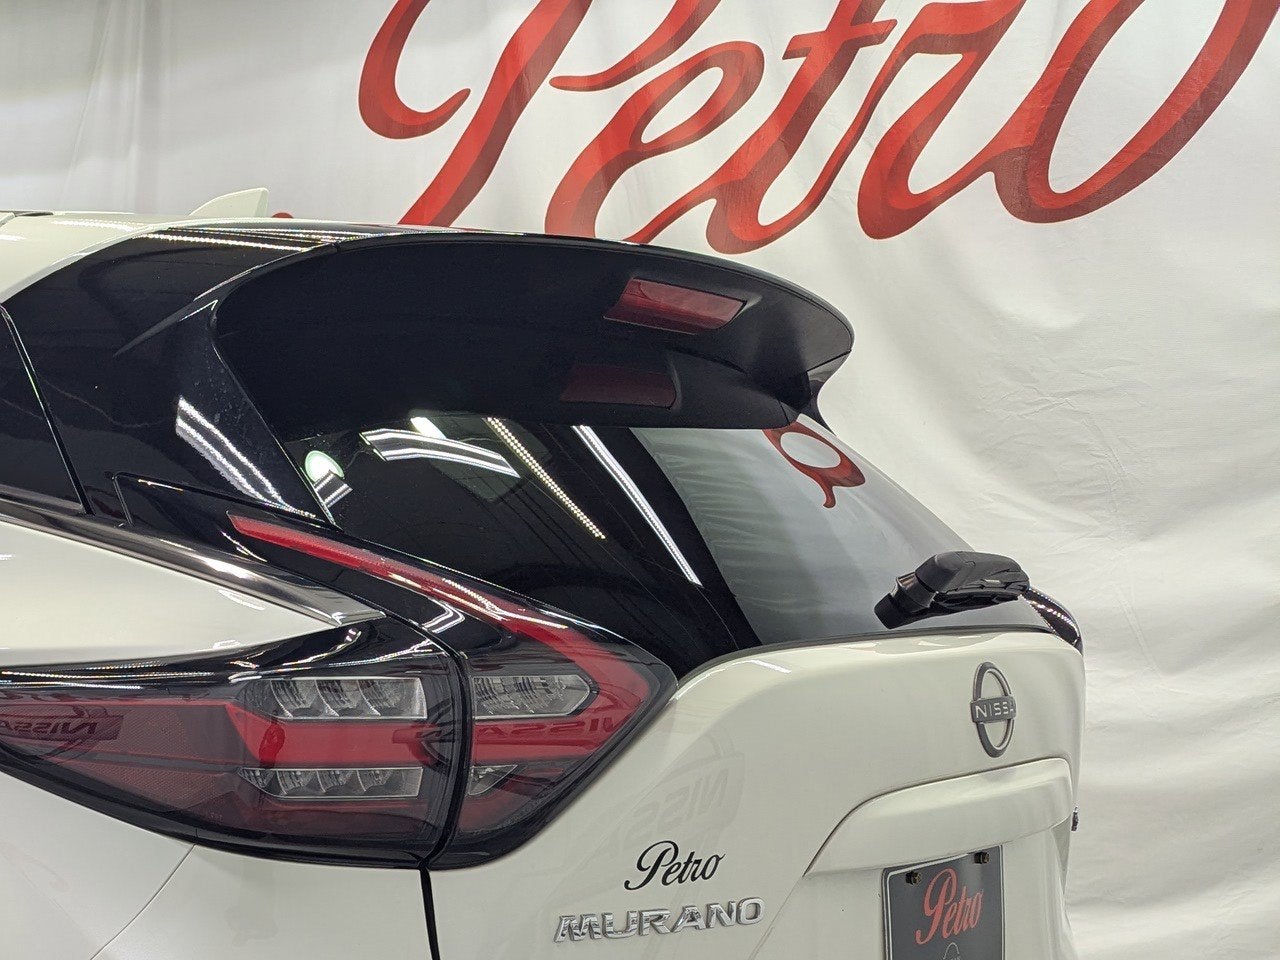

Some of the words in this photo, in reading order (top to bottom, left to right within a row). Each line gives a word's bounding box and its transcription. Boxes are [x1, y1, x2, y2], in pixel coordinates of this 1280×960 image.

[624, 840, 726, 891] Petro
[553, 896, 766, 943] MURANO
[915, 868, 984, 945] Petro
